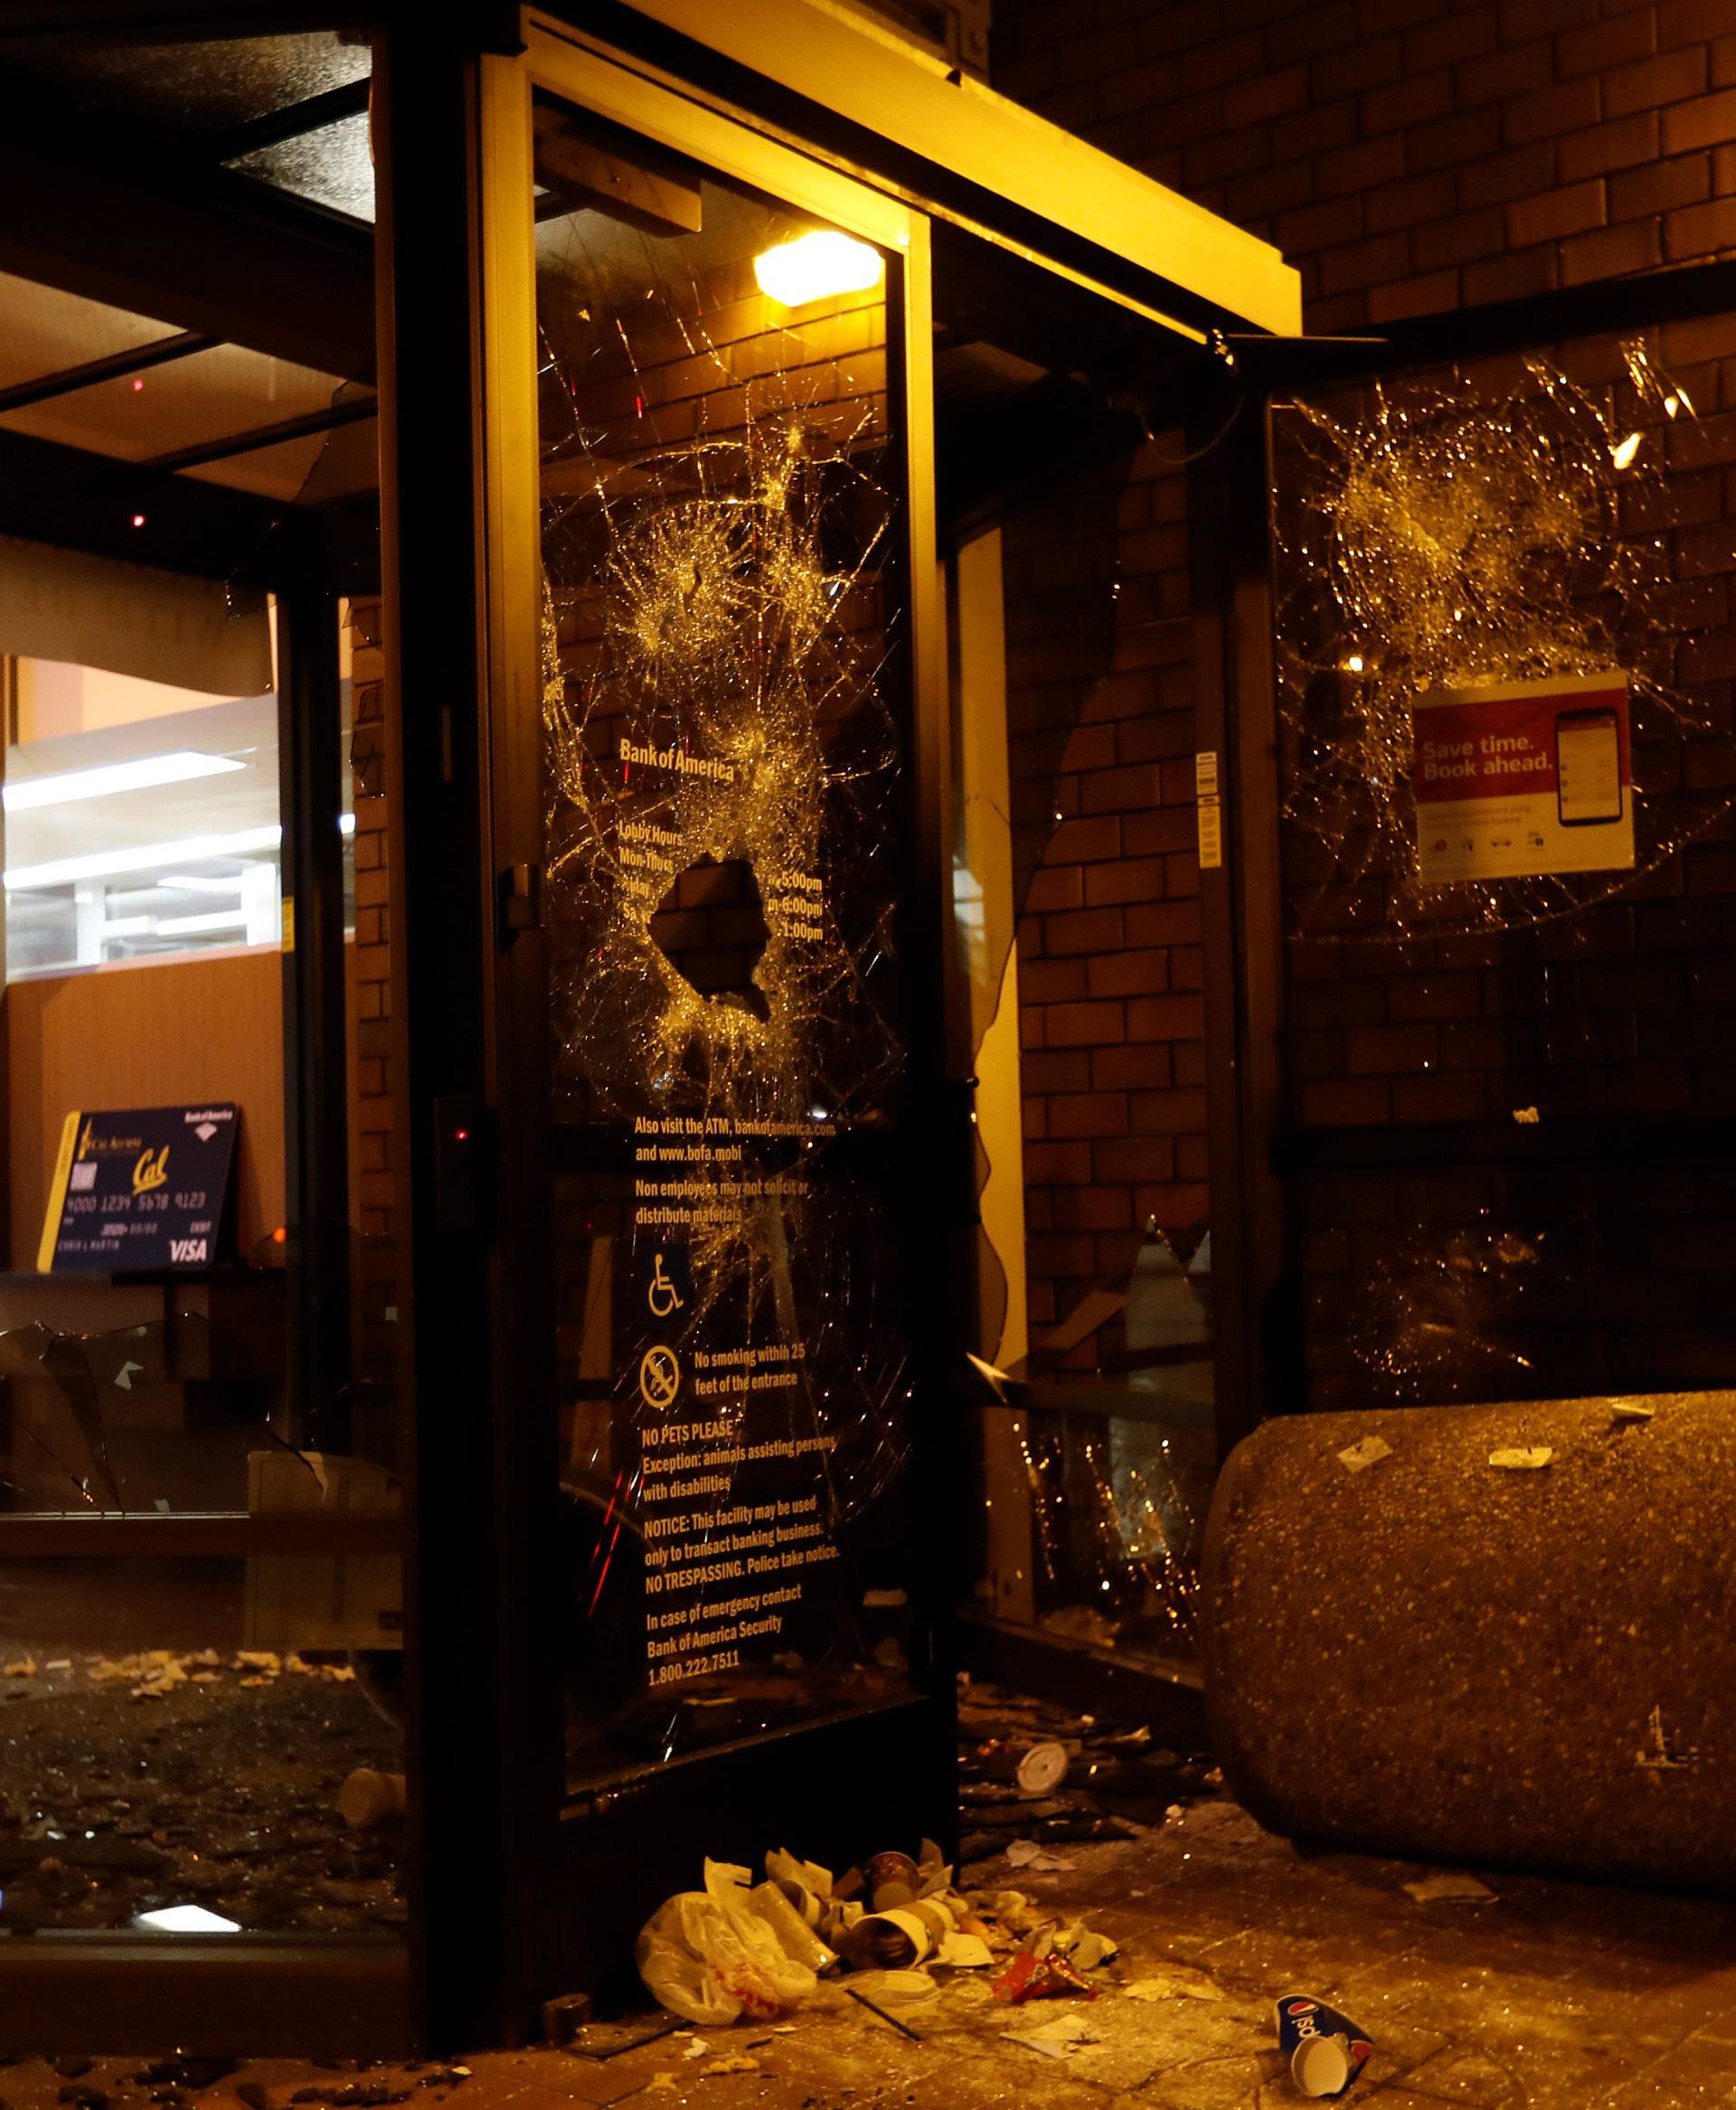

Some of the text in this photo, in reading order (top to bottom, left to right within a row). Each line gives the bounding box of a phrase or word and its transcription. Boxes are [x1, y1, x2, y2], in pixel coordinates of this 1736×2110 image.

[620, 739, 734, 782] Bank of America
[1423, 735, 1535, 760] Save time.
[1424, 752, 1552, 780] Book ahead.
[619, 820, 684, 846] Lobby Hours
[635, 1116, 658, 1135] Also
[661, 1117, 684, 1134] visit
[685, 1117, 703, 1135] the
[705, 1117, 732, 1136] ATM,
[636, 1144, 741, 1162] and www.bofa.mobi
[132, 1144, 170, 1196] Cal
[636, 1178, 809, 1199] Non employees may not solicit or
[636, 1207, 741, 1224] distribute materials
[169, 1239, 207, 1262] VISA
[694, 1342, 806, 1368] No smoking within 25
[695, 1372, 798, 1395] feet of the entrance
[642, 1419, 733, 1446] NO PETS PLEASE
[643, 1436, 835, 1474] Exception: animals assisting persons
[643, 1474, 731, 1502] with disabilities
[644, 1494, 816, 1539] NOTICE: This facility may be used
[645, 1550, 669, 1568] only
[671, 1547, 682, 1561] to
[684, 1538, 731, 1560] transact
[732, 1530, 775, 1548] banking
[646, 1544, 840, 1594] NO TRESPASSING. Police take notice.
[646, 1584, 802, 1631] In case of emergency contact
[647, 1616, 782, 1659] Bank of America Security
[648, 1650, 741, 1687] 1.800.222.7511
